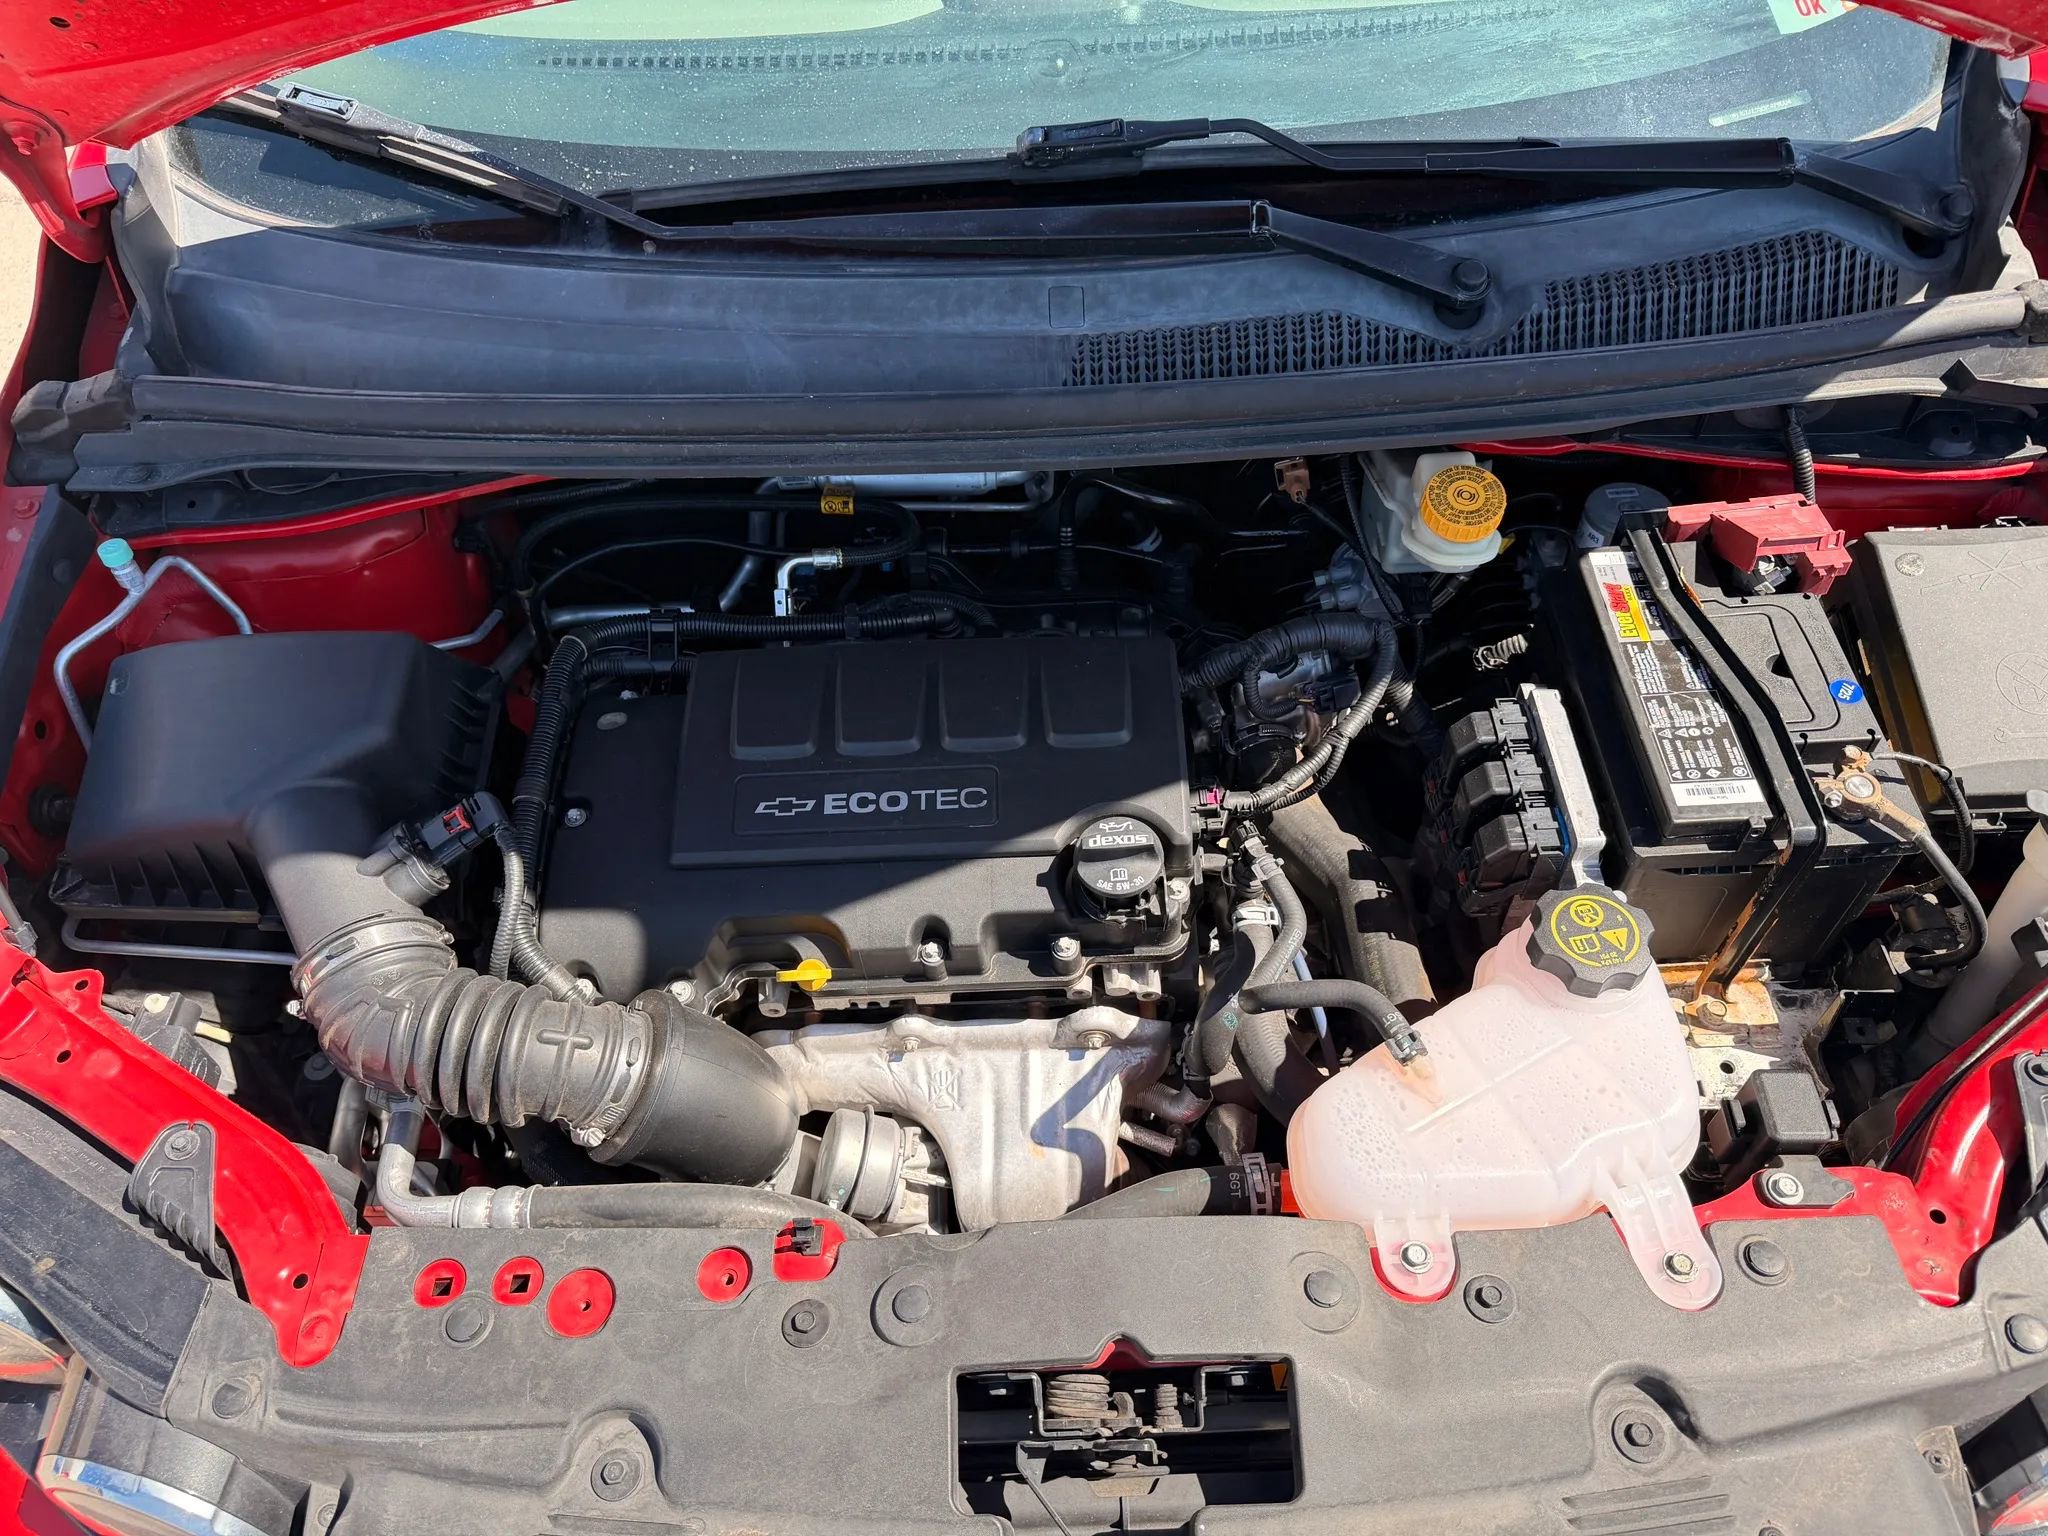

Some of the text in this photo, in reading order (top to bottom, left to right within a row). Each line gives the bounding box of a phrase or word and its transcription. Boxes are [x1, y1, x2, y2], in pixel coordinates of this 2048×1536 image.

[1794, 0, 1827, 17] OK
[823, 787, 988, 815] ECOTEC
[1088, 834, 1149, 847] dexos
[1096, 875, 1145, 891] SAE 5W-30
[1229, 1172, 1242, 1199] 6GT
